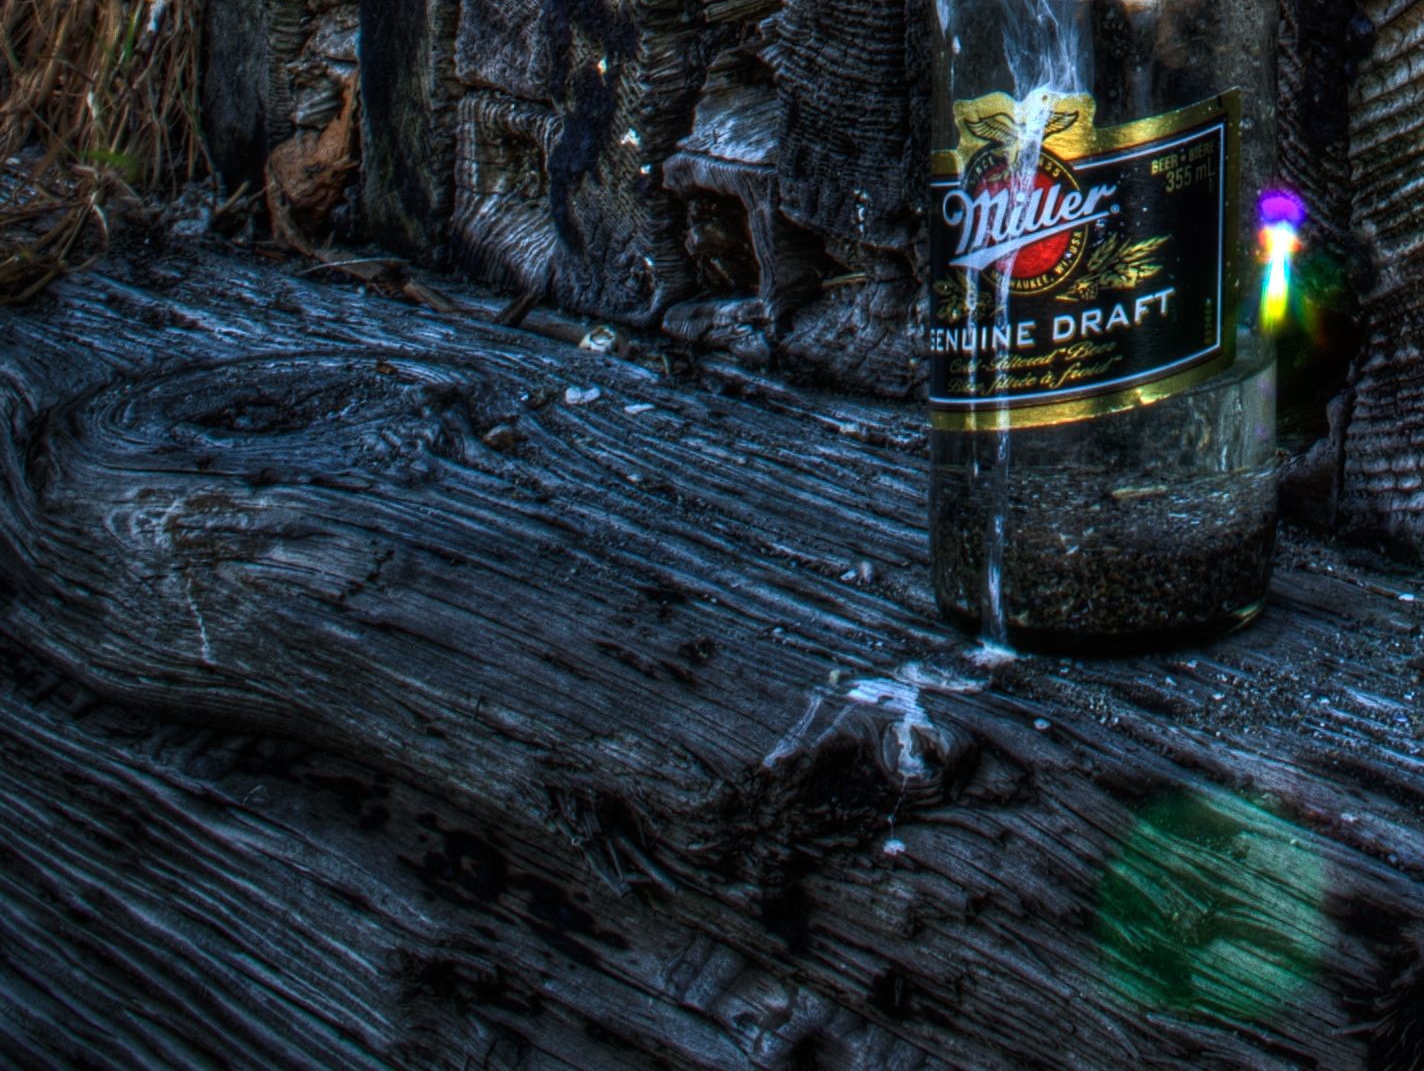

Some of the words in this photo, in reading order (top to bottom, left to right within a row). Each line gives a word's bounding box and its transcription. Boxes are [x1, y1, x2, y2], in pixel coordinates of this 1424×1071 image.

[1151, 153, 1179, 175] BEER
[1165, 164, 1192, 193] 355
[943, 182, 1117, 256] Miller
[1053, 288, 1176, 342] DRAFT
